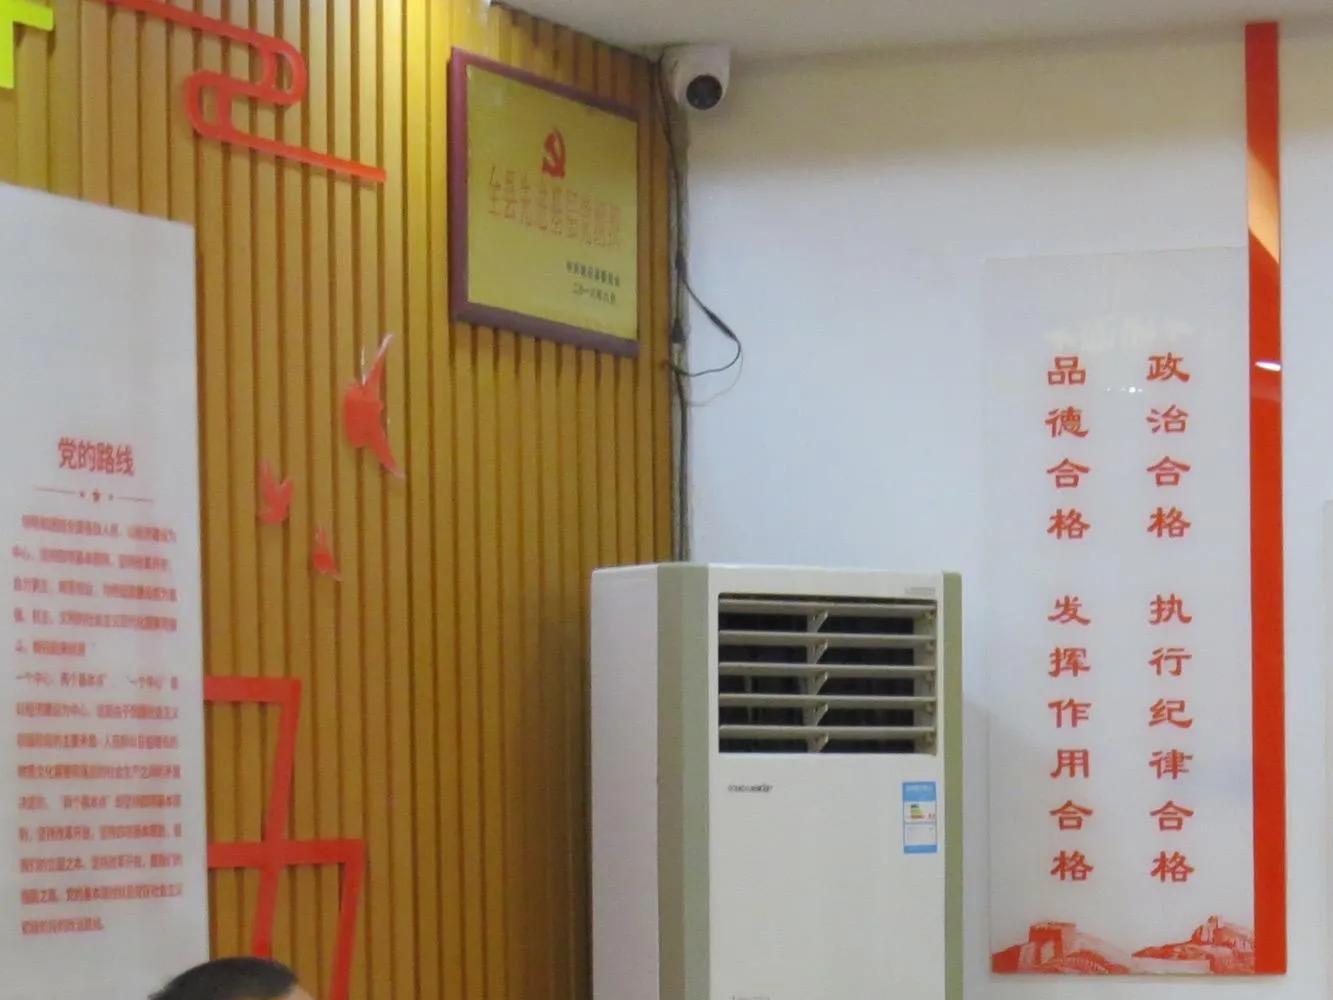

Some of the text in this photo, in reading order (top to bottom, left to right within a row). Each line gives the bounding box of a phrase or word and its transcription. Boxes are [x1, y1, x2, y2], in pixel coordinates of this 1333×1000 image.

[58, 437, 135, 476] 党的路线
[1045, 355, 1093, 882] 品德合格 发挥作用合格
[1146, 352, 1194, 883] 政治合格 执行纪律合格
